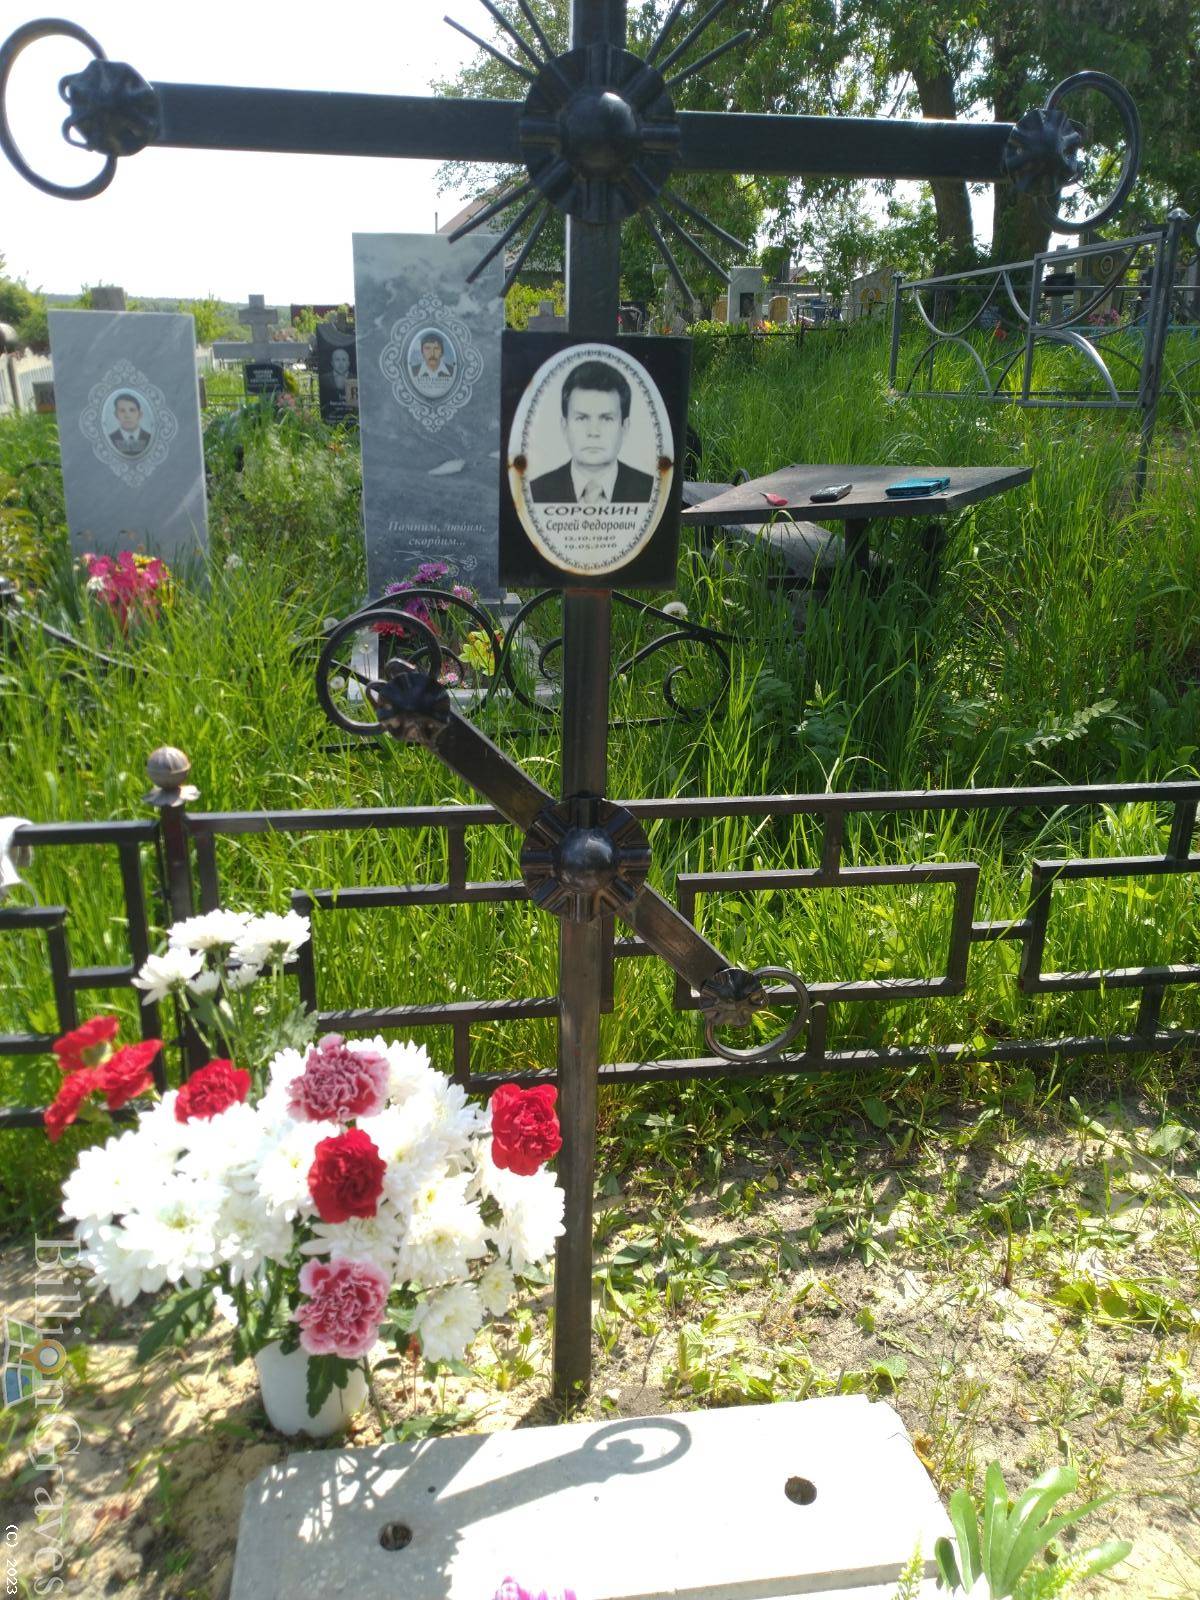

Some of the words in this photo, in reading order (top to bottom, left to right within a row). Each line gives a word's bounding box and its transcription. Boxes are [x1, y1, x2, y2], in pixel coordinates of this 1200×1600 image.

[543, 506, 638, 516] СОРОКИН
[545, 519, 580, 534] Сергей
[581, 518, 637, 534] Федорович
